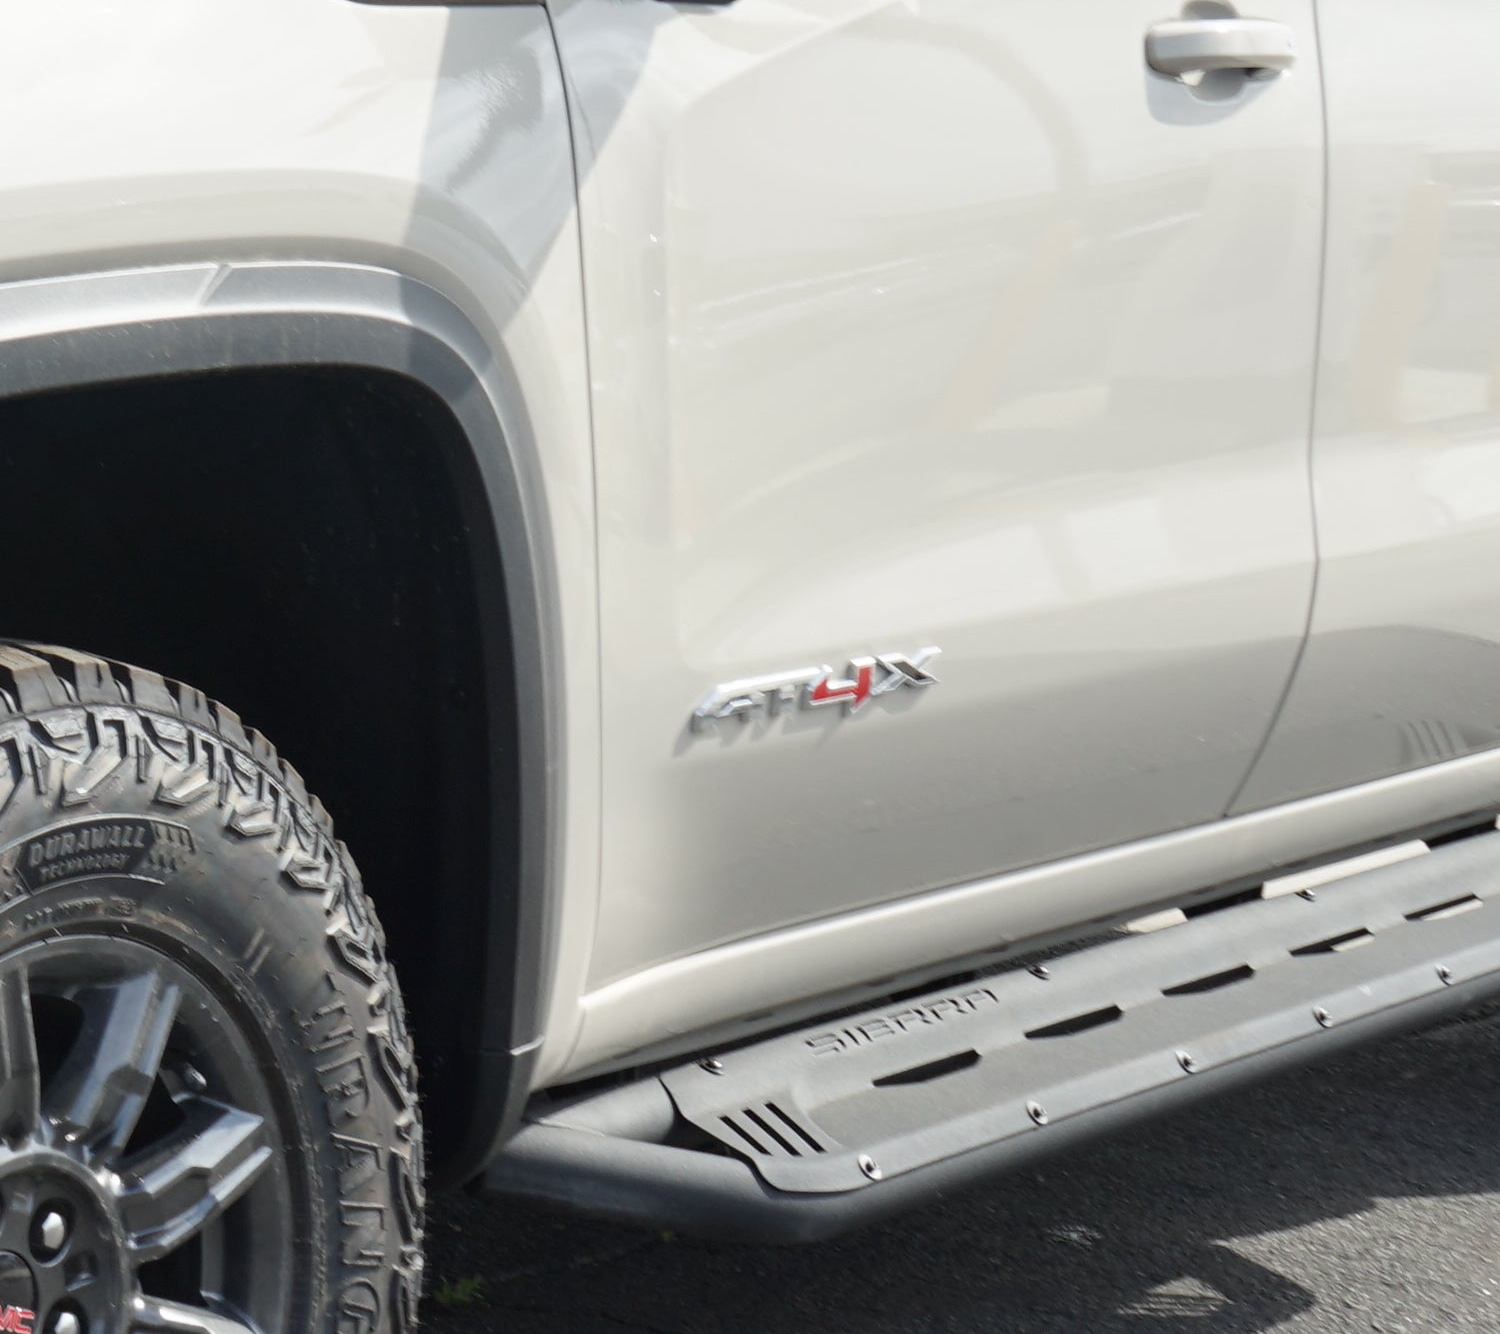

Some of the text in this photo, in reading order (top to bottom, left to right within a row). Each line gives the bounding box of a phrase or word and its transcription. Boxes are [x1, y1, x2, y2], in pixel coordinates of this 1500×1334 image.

[690, 645, 943, 733] AT4X
[29, 824, 146, 868] DURAWALL
[805, 989, 1000, 1055] SIERRA
